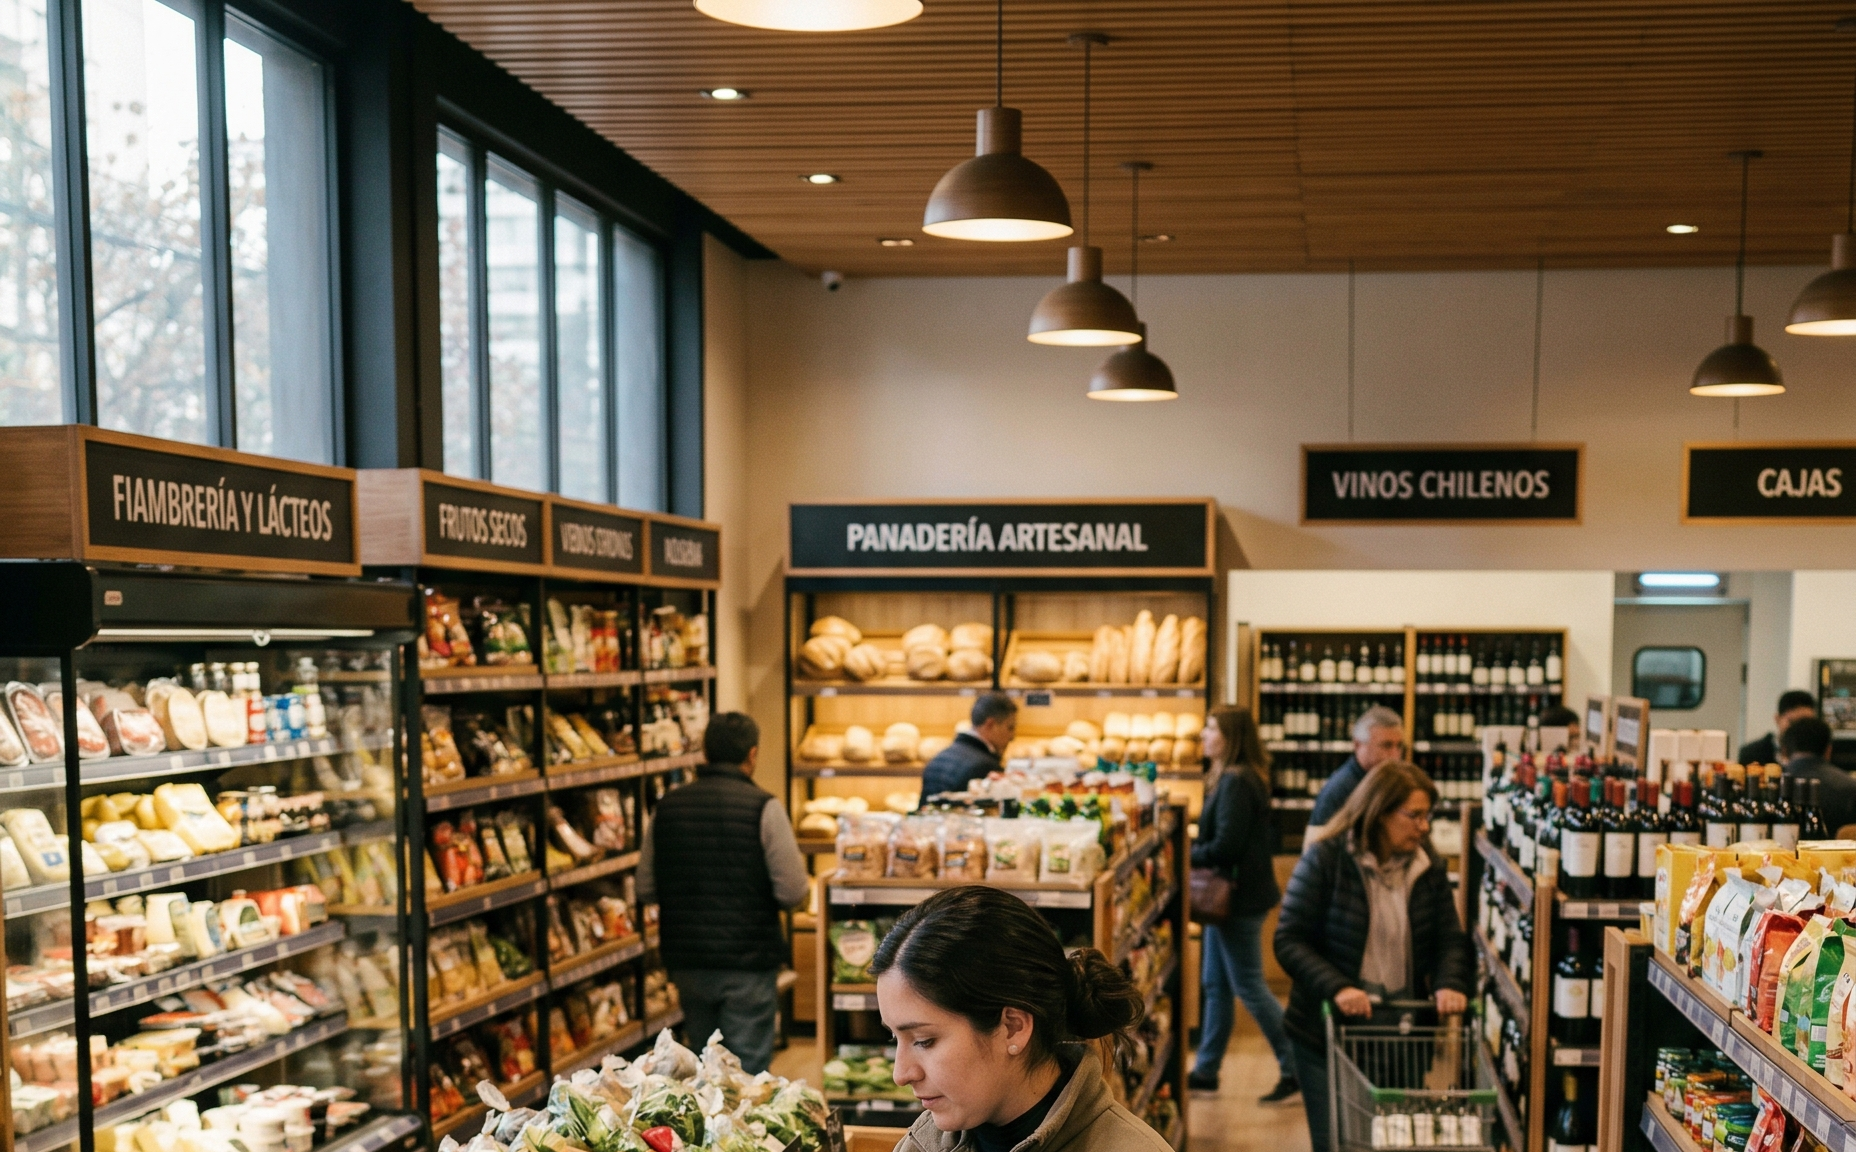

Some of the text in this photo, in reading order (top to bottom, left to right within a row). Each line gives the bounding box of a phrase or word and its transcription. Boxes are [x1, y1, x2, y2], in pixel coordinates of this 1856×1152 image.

[1331, 469, 1550, 500] VINOS CHILENOS
[1756, 467, 1843, 498] CAJAS
[113, 474, 333, 542] FIAMBRERÍA Y LÁCTEOS
[439, 503, 489, 545] FRUTOS
[489, 511, 527, 548] SECOS
[846, 516, 1148, 552] PANADERÍA ARTESANAL
